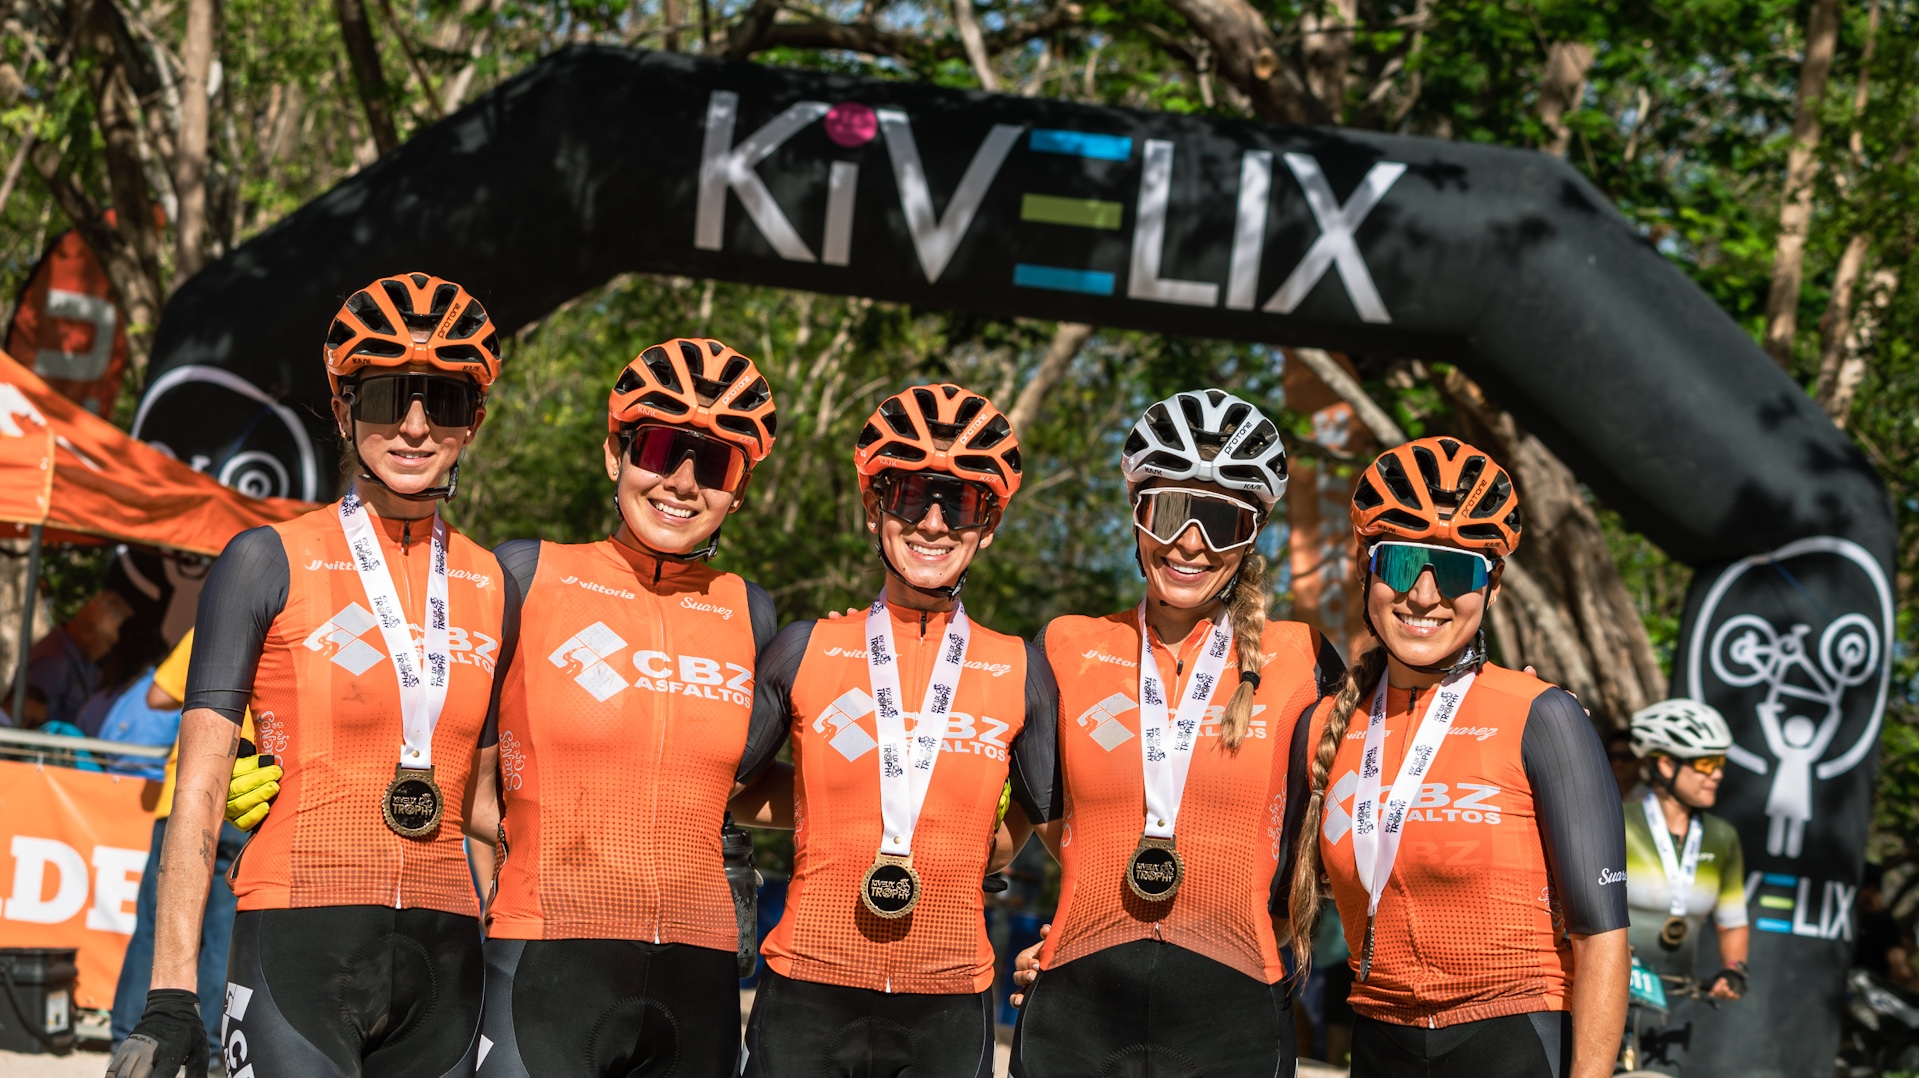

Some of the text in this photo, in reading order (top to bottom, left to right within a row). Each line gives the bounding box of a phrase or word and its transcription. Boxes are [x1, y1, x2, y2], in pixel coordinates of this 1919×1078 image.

[353, 539, 369, 572] TROPHY
[447, 568, 490, 588] uarez
[580, 580, 635, 600] vittoria
[374, 597, 390, 628] TROPHY
[680, 597, 733, 620] Suarez
[871, 637, 880, 666] TROPHY
[951, 637, 965, 665] TROPHY
[1097, 654, 1140, 668] vittor
[396, 653, 410, 688] TROPHY
[436, 654, 446, 687] TROPHY
[633, 650, 751, 696] CBZ
[963, 660, 1011, 677] uarez
[634, 677, 751, 709] ASFALTOS
[877, 688, 887, 718] TROPHY
[937, 686, 952, 714] TROPHY
[1197, 675, 1214, 701] TROPHY
[1439, 693, 1459, 723] TROPHY
[1146, 728, 1155, 762] TROPHY
[1180, 720, 1196, 751] TROPHY
[1446, 726, 1499, 741] uarez
[883, 744, 893, 778] TROPHY
[920, 737, 937, 770] TROPHY
[1413, 746, 1434, 777] TROPHY
[392, 803, 433, 817] TROPHY
[1357, 801, 1366, 835] TROPHY
[1390, 801, 1407, 834] TROPHY
[2, 835, 150, 936] DE
[1136, 870, 1174, 882] TROPHY
[871, 887, 910, 900] TROPHY
